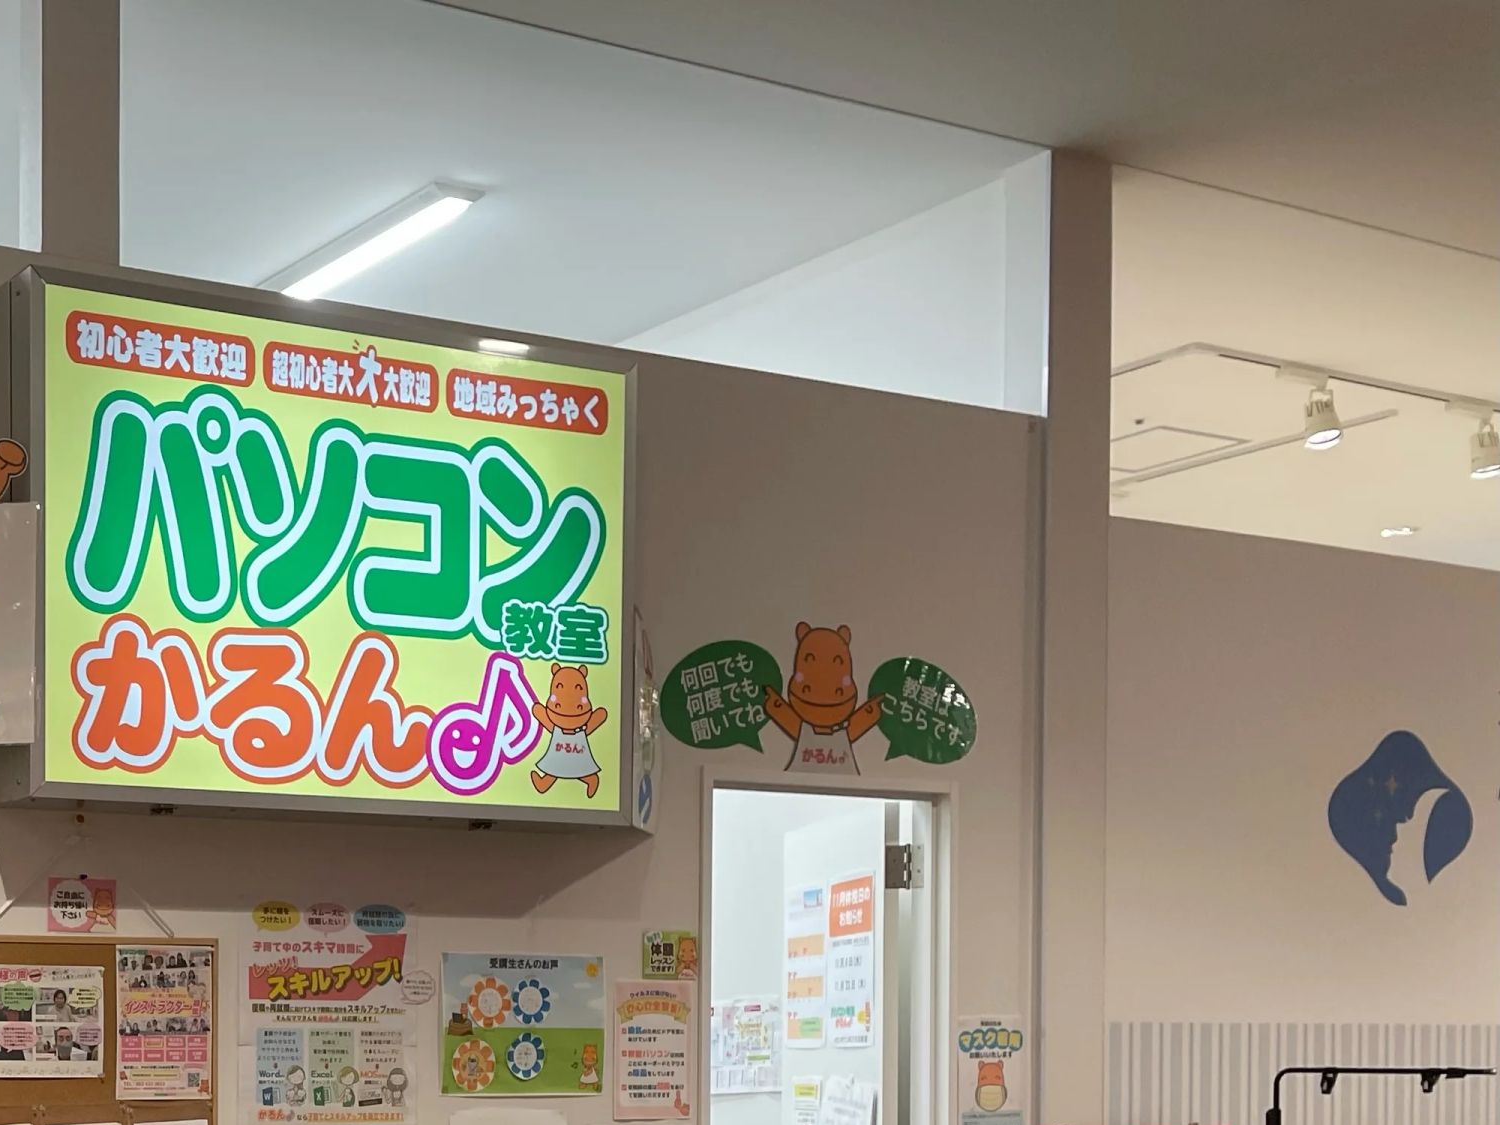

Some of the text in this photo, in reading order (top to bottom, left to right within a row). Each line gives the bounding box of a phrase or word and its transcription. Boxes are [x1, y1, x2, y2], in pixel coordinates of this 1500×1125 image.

[76, 319, 248, 379] 初心者大歓迎
[452, 375, 600, 428] 地域みっちゃく
[66, 384, 606, 649] パソコン
[500, 601, 610, 664] 教室
[681, 652, 754, 692] 何回でも
[72, 612, 434, 788] かるん
[686, 678, 760, 718] 何度でも
[691, 702, 766, 744] 聞いてね
[881, 692, 964, 746] こちらです
[802, 748, 838, 764] かるん
[53, 900, 88, 909] お持ち帰り
[60, 911, 82, 919] 下さい
[260, 916, 292, 924] つけたい!
[839, 911, 863, 927] お知らせ
[253, 941, 364, 954] 子育て中のスキマ時間に
[252, 957, 298, 978] レッツ!
[489, 958, 559, 969] 受講生さんのお声
[651, 965, 674, 973] できます!
[267, 957, 402, 1001] スキルアップ!
[125, 1000, 192, 1015] インストラクター
[258, 1110, 284, 1120] かるん
